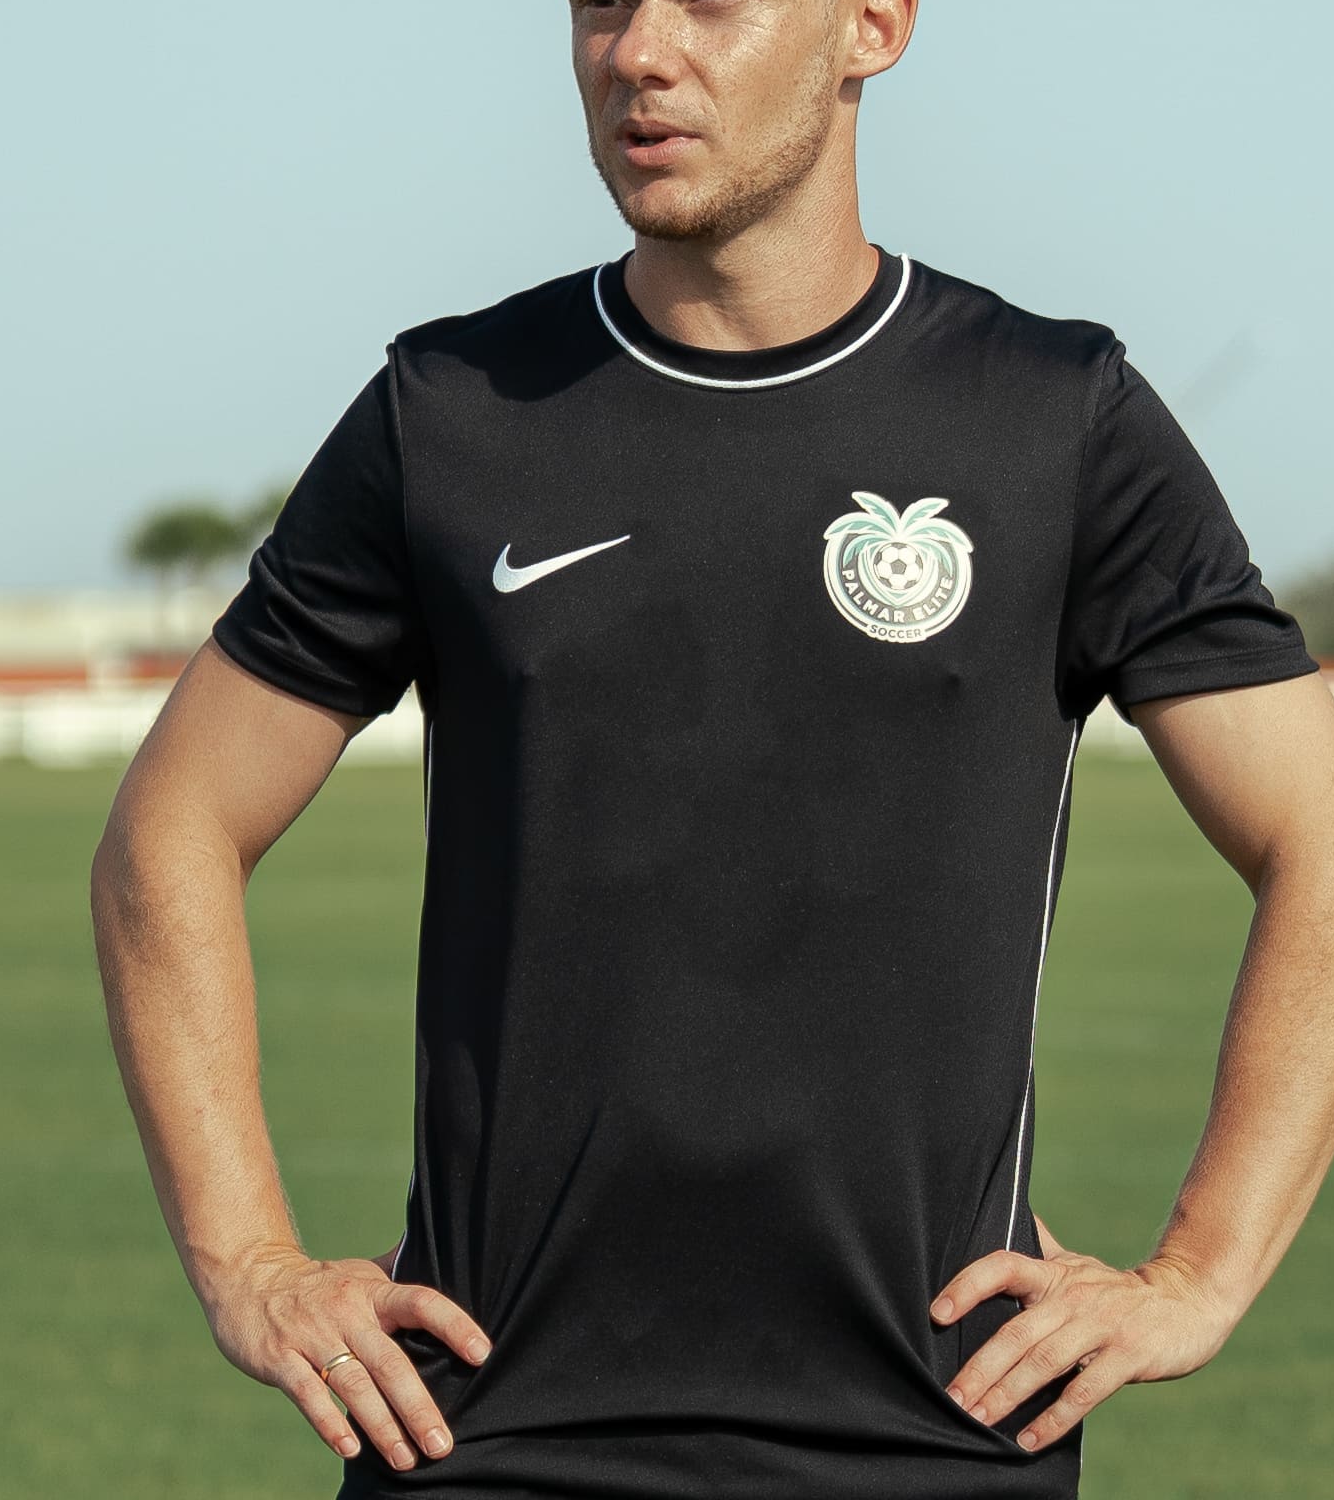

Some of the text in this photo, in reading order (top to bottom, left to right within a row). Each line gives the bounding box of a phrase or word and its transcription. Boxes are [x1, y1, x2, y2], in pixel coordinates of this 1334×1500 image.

[841, 569, 954, 623] PALMAR ELITE
[869, 624, 922, 639] SOCCER
